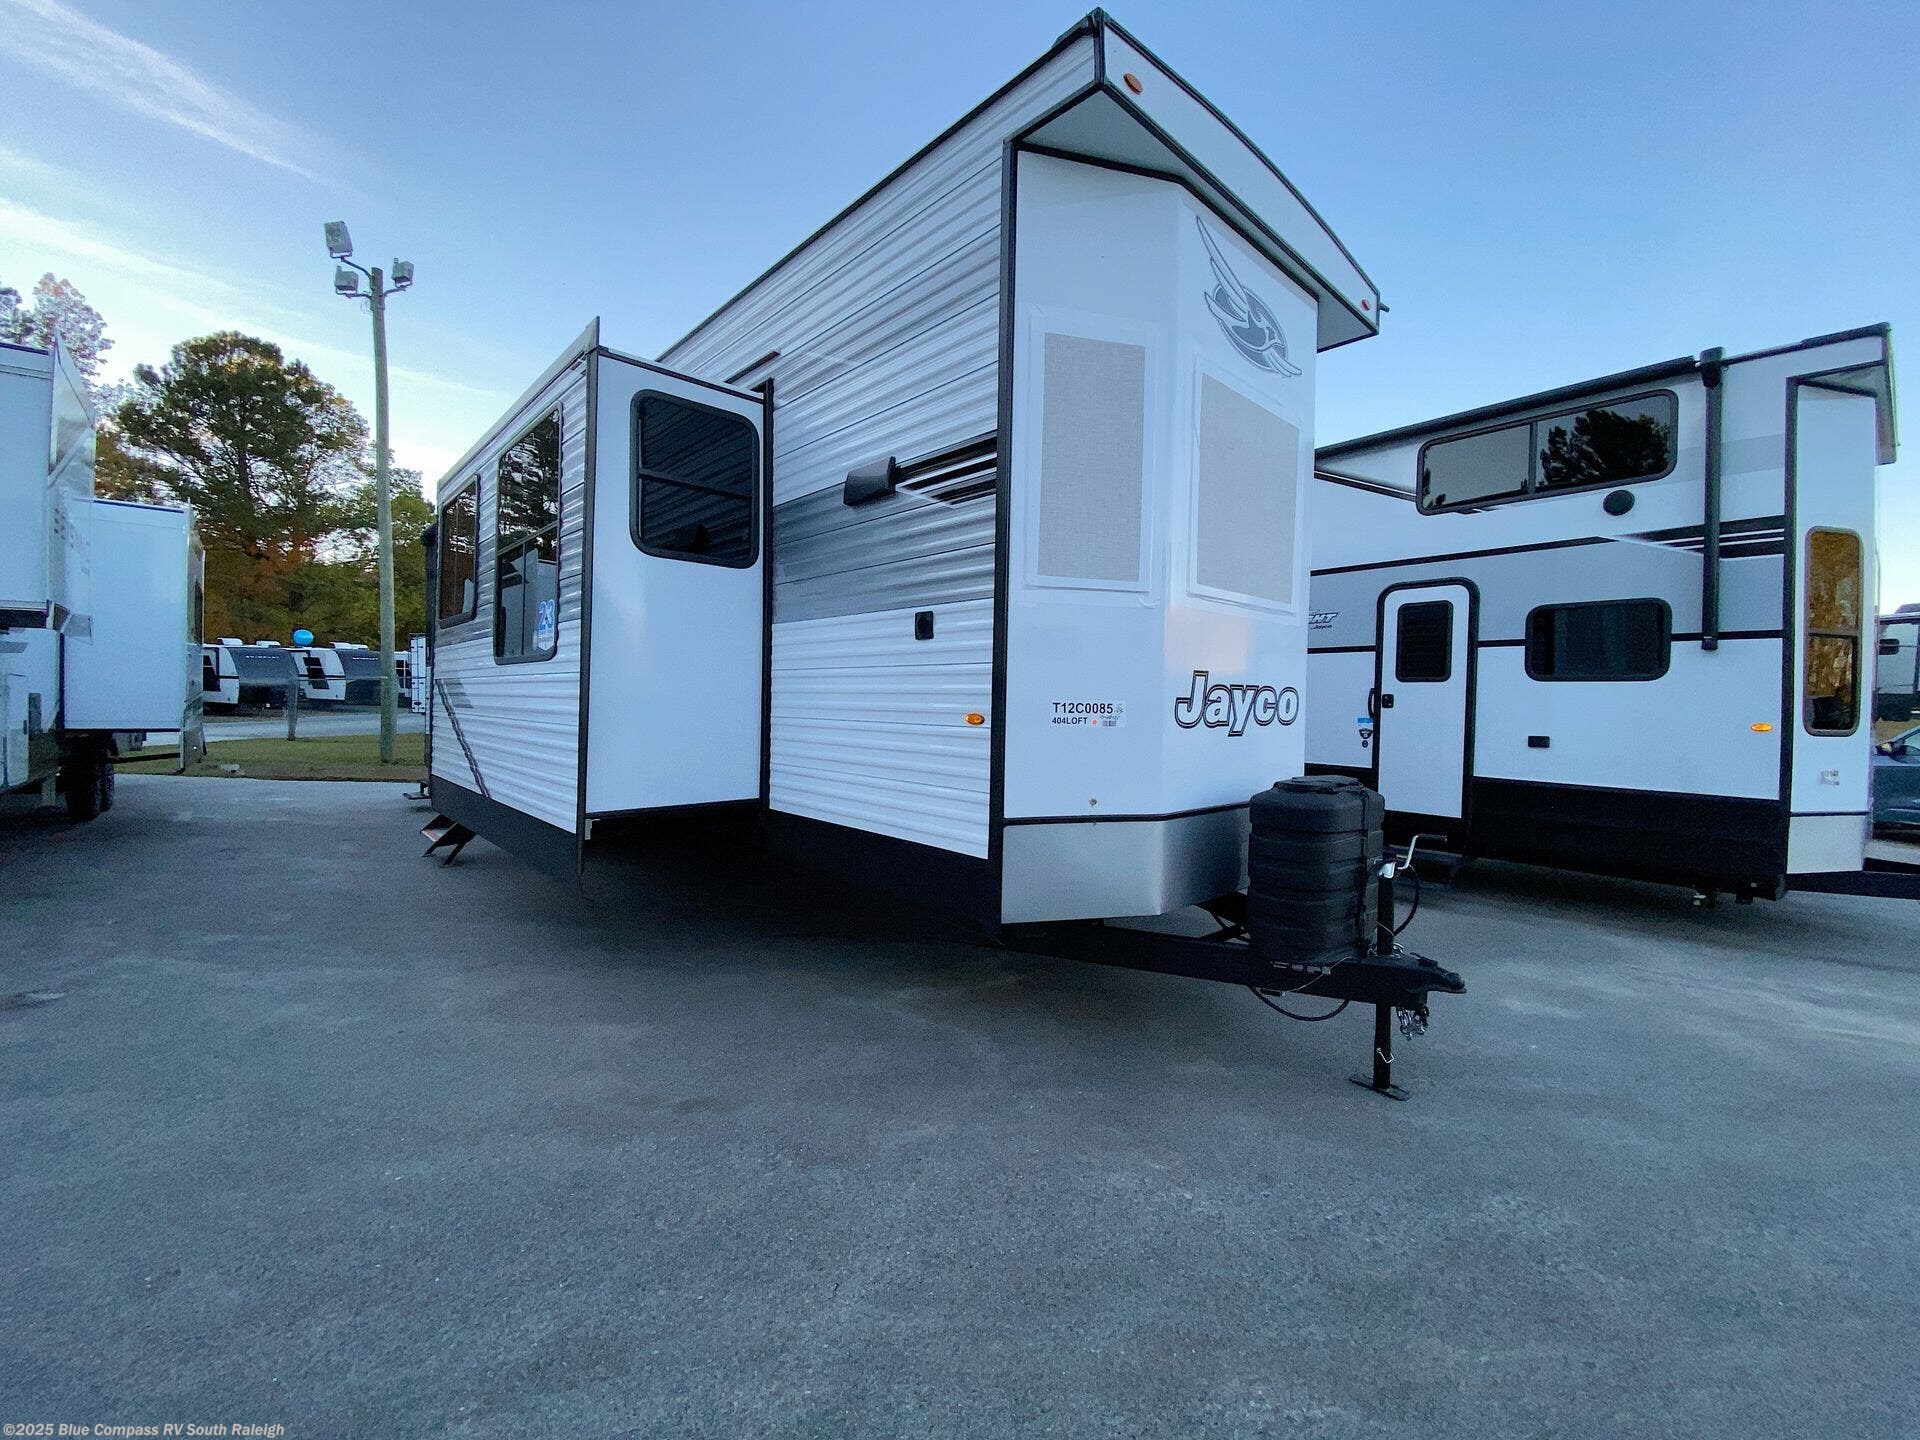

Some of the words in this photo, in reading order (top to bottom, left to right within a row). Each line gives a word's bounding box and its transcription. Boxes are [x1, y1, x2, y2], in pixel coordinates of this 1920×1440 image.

[1052, 702, 1114, 714] T12C0085
[1174, 670, 1299, 737] Jayco
[1051, 717, 1088, 725] 404LOFT
